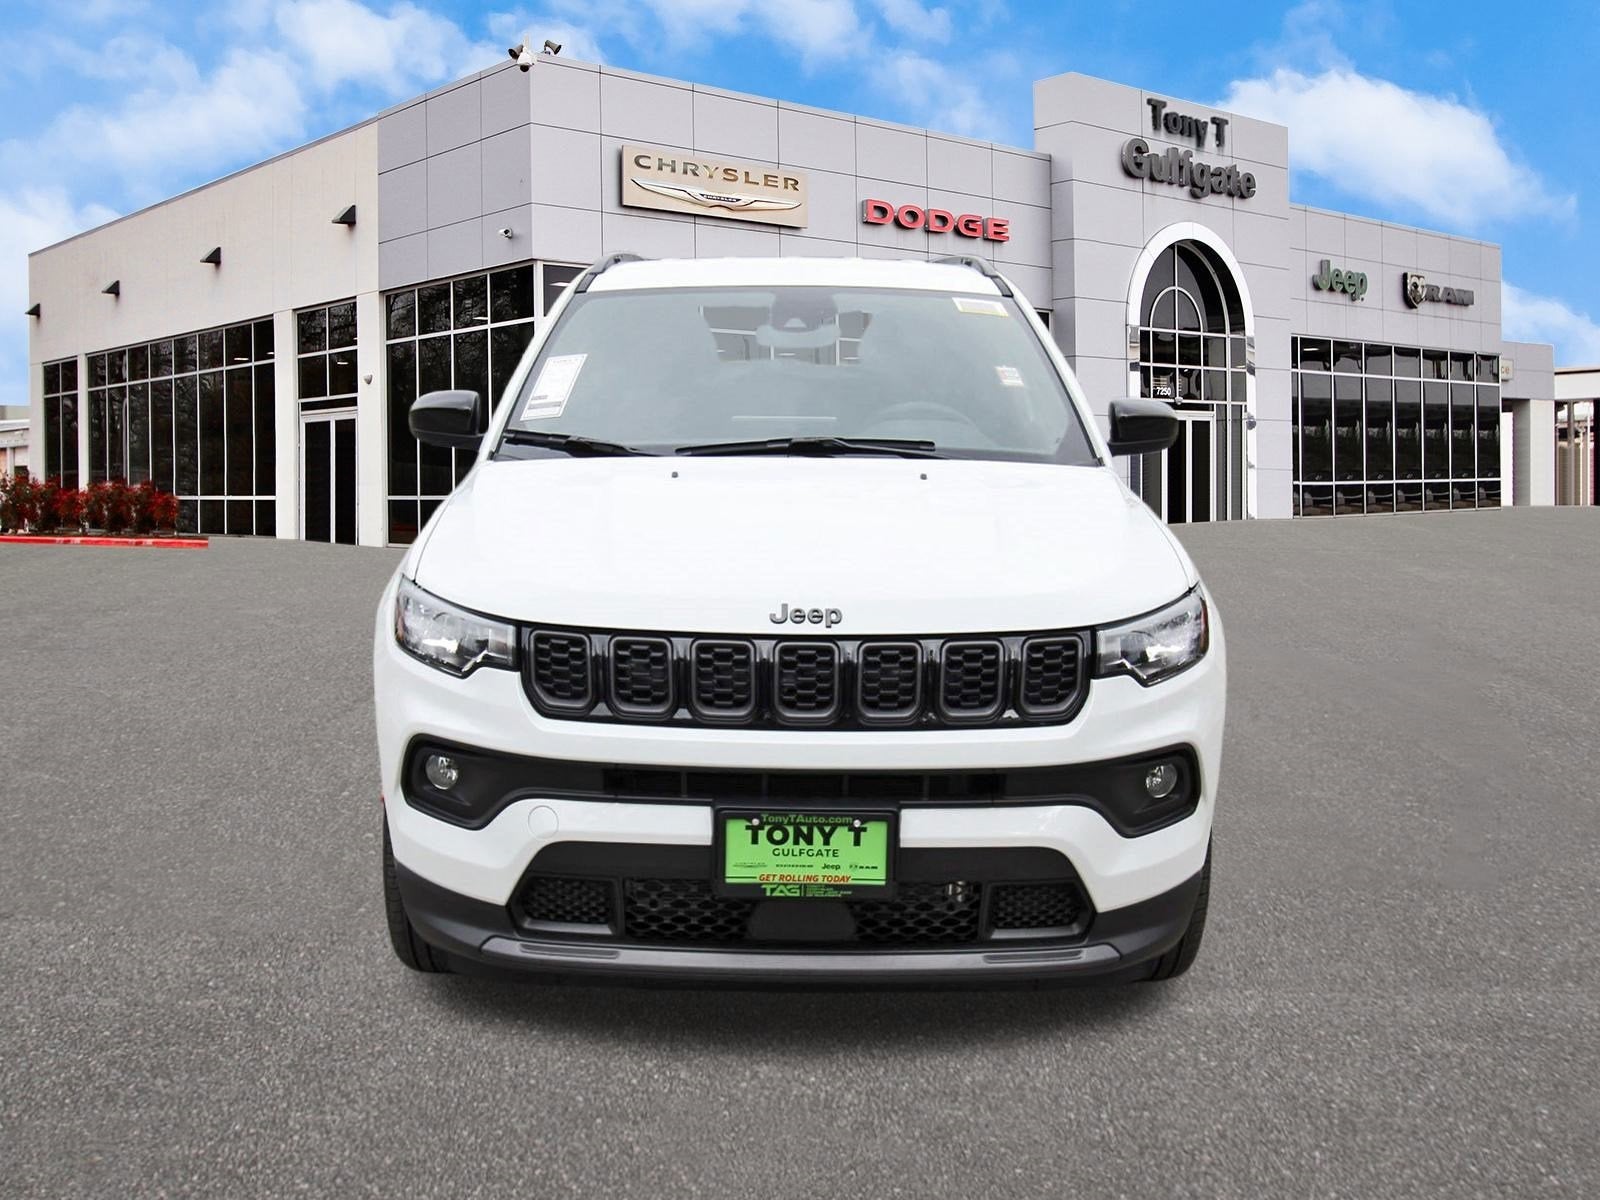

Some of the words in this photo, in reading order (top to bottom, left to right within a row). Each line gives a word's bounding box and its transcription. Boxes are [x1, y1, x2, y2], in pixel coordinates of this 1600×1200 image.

[1147, 98, 1208, 148] Tony
[1210, 117, 1229, 148] T
[633, 154, 800, 192] CHRYSLER
[1121, 138, 1257, 199] Gulfgate
[862, 199, 1010, 242] DODGE
[1313, 259, 1368, 301] Jeep
[1423, 284, 1475, 306] RAM
[1156, 387, 1172, 395] 7250
[769, 603, 843, 628] Jeep
[761, 813, 853, 825] TonyTAuto.com
[745, 824, 839, 846] TONY
[847, 825, 867, 847] T
[772, 848, 840, 857] GULFGATE
[821, 863, 841, 871] Jeep
[759, 874, 777, 882] GET
[779, 874, 819, 882] ROLLING
[821, 875, 851, 883] TODAY
[761, 884, 801, 897] TAG
